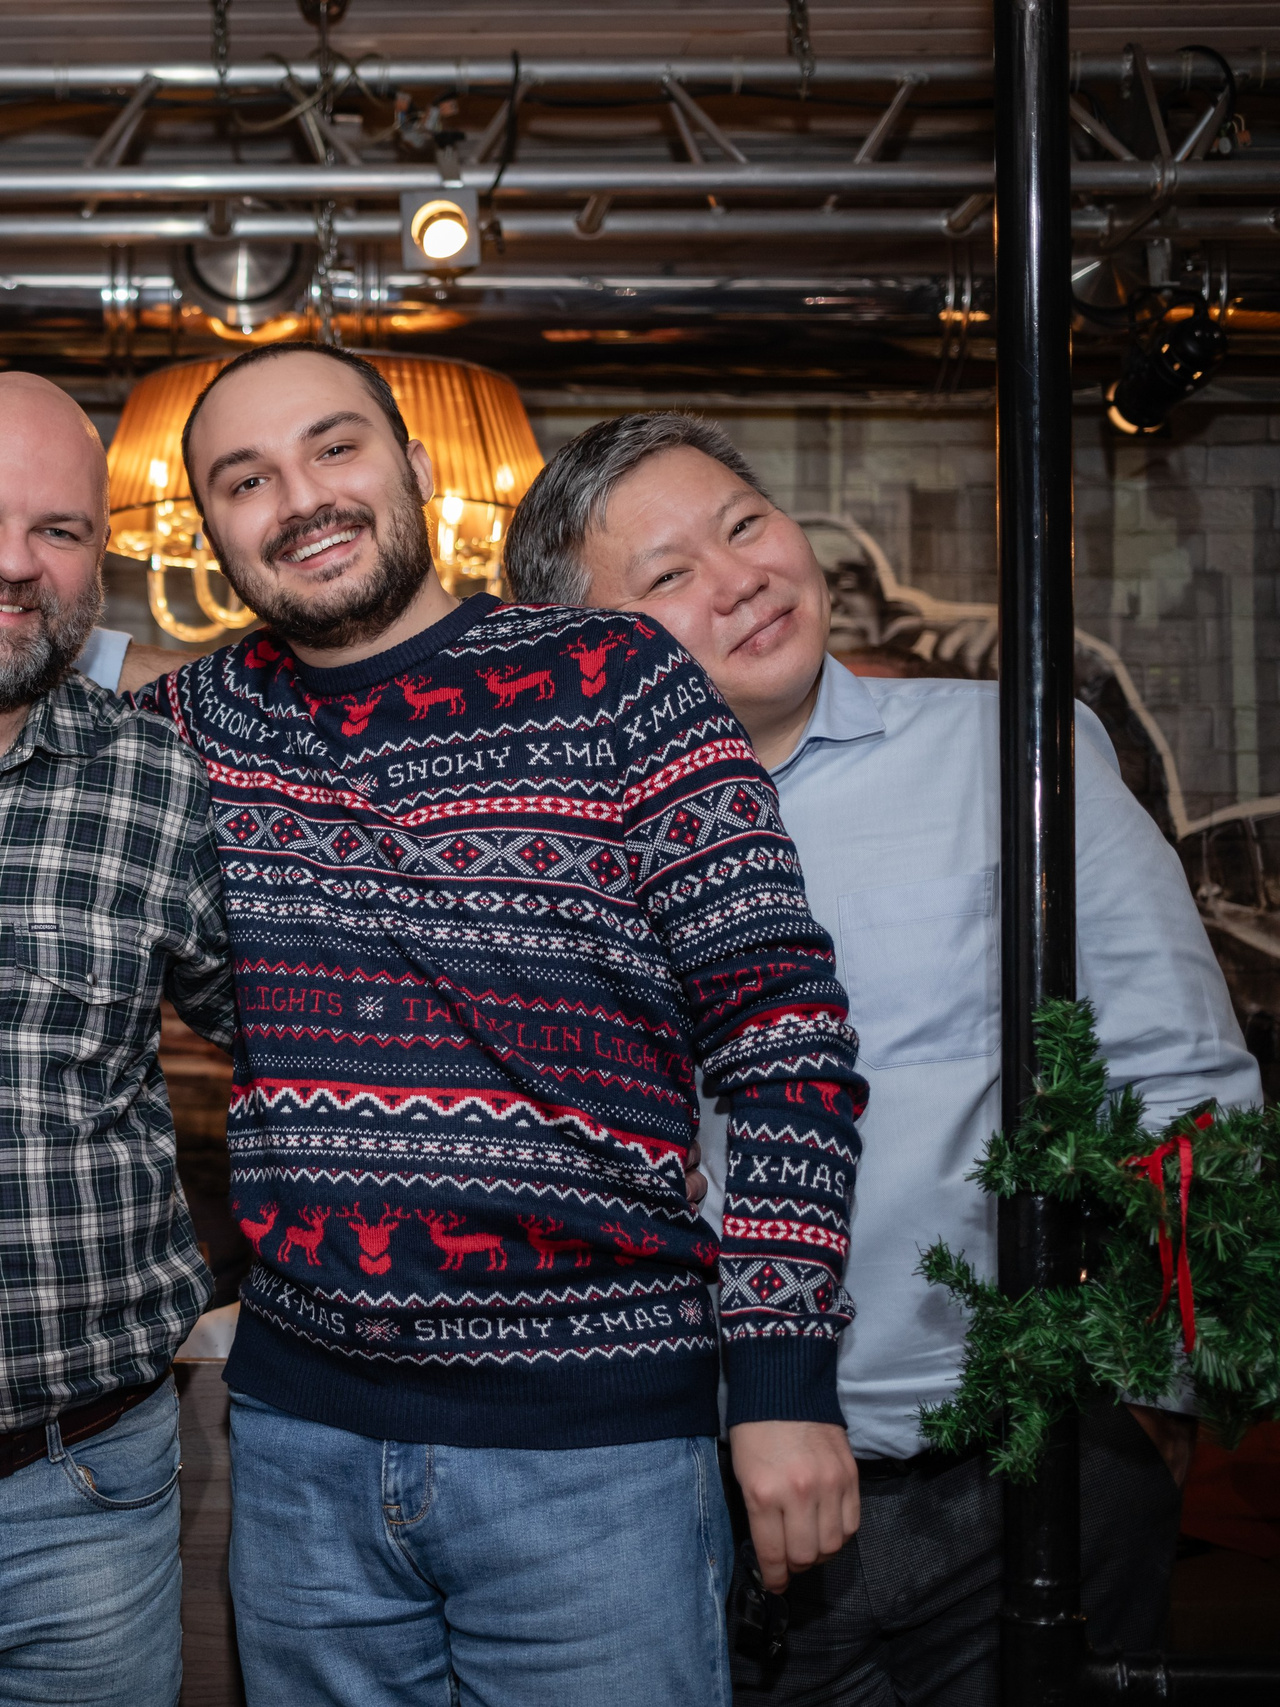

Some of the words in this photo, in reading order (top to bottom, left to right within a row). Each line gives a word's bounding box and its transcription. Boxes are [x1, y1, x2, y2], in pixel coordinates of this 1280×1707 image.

[623, 676, 708, 750] X-MAS
[387, 745, 511, 788] SNOWY
[244, 986, 343, 1016] LIGHTS
[593, 1030, 693, 1083] LIGHTS
[747, 1154, 846, 1198] X-MAS
[276, 1283, 346, 1334] X-MAS
[414, 1317, 554, 1341] SNOWY
[568, 1304, 673, 1336] X-MAS
